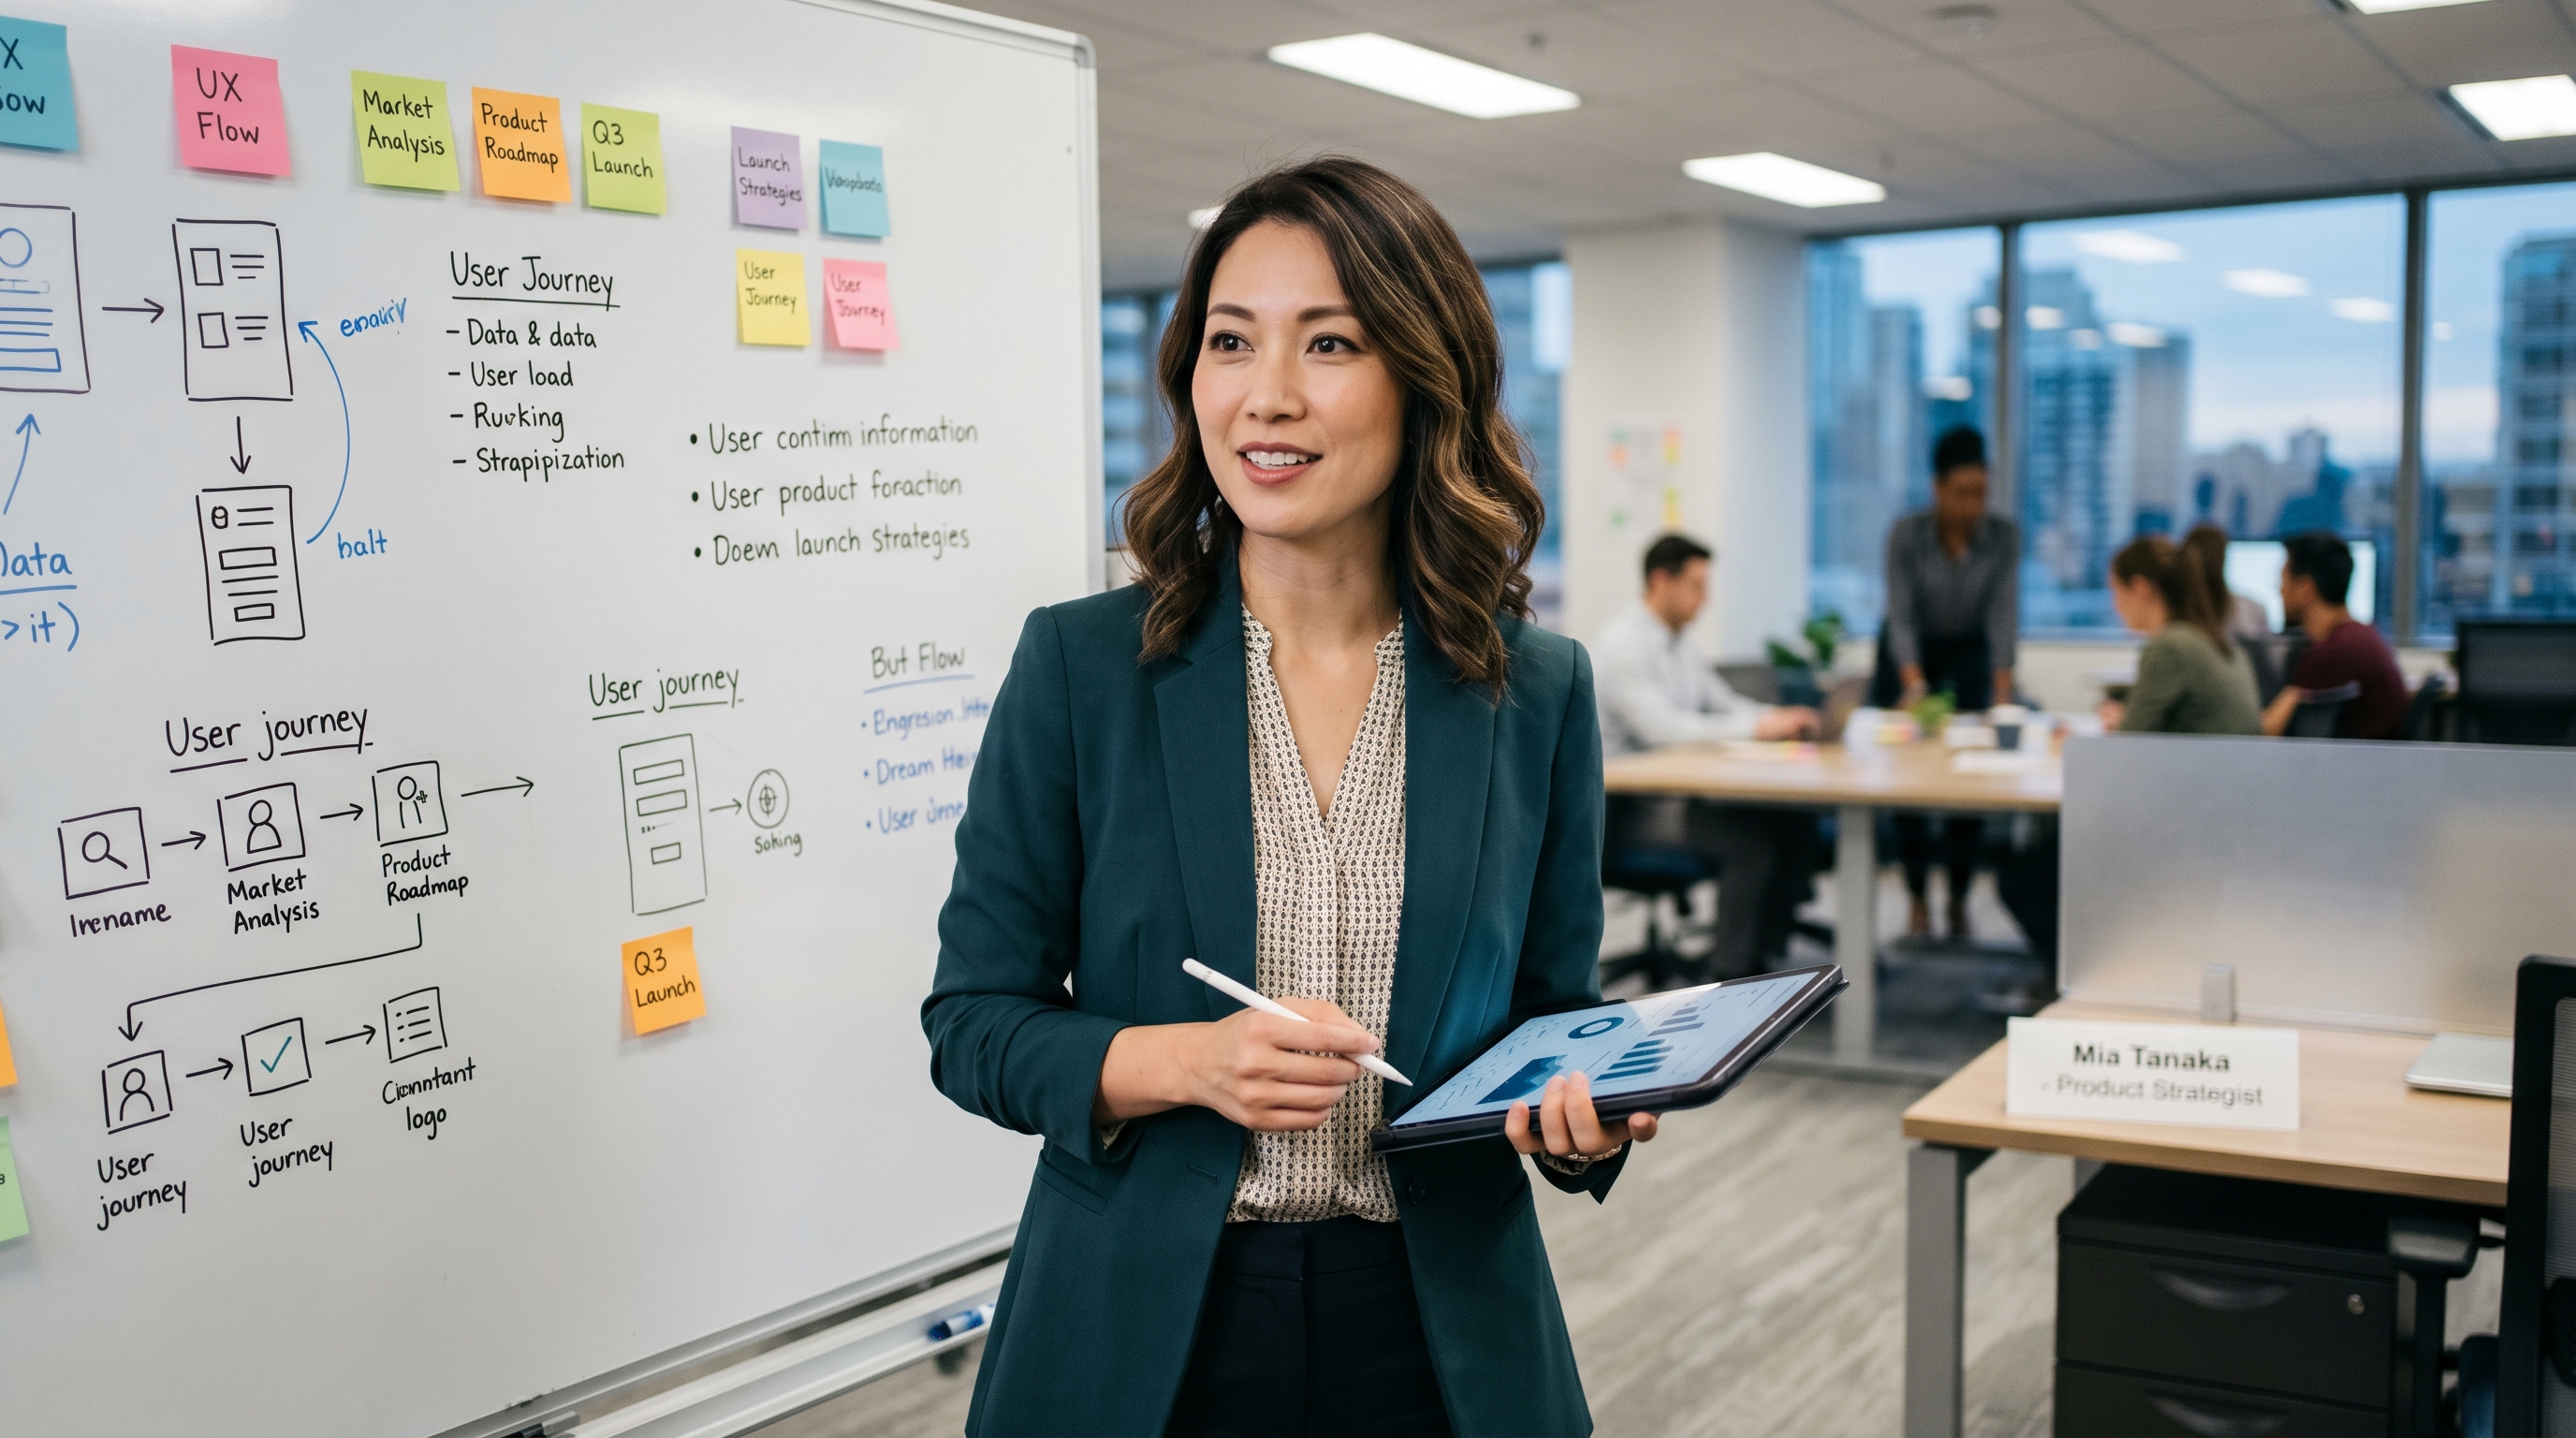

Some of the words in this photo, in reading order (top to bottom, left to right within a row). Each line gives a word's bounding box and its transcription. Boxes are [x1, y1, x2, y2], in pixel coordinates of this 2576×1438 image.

[197, 67, 242, 102] UX
[0, 94, 45, 114] ow
[363, 89, 432, 119] Market
[481, 103, 548, 132] Product
[198, 111, 258, 144] Flow
[593, 120, 623, 145] Q3
[368, 125, 445, 162] Analysis
[485, 137, 558, 173] Roadmap
[593, 152, 652, 178] Launch
[739, 147, 790, 171] Launch
[739, 177, 802, 206] Strategies
[451, 251, 509, 286] User
[521, 256, 613, 312] Journey
[744, 261, 775, 279] User
[830, 271, 861, 293] User
[745, 287, 797, 314] Journey
[836, 300, 886, 327] Journey
[467, 318, 519, 345] Data
[529, 320, 540, 345] &
[550, 321, 596, 347] data
[471, 361, 518, 387] User
[529, 360, 573, 386] load
[710, 423, 762, 454] User
[476, 445, 624, 482] Strapipization
[711, 481, 763, 511] User
[780, 474, 857, 516] product
[796, 528, 860, 556] launch
[871, 646, 908, 679] But
[919, 642, 964, 671] Flow
[590, 673, 642, 706] User
[653, 669, 739, 713] journey
[166, 717, 242, 757] User
[258, 709, 368, 760] journey
[876, 758, 934, 785] Dream
[879, 808, 916, 834] User
[382, 844, 451, 877] Product
[227, 869, 306, 904] Market
[387, 874, 469, 906] Roadmap
[233, 900, 320, 933] Analysis
[635, 947, 666, 976] Q3
[636, 975, 695, 1007] Launch
[2072, 1043, 2120, 1065] Mia
[2131, 1045, 2231, 1072] Tanaka
[2056, 1074, 2144, 1100] Product
[2152, 1078, 2263, 1108] Strategist
[241, 1119, 292, 1146] User
[406, 1106, 446, 1140] logo
[97, 1153, 154, 1183] User
[248, 1141, 333, 1187] journey
[96, 1181, 187, 1230] journey
